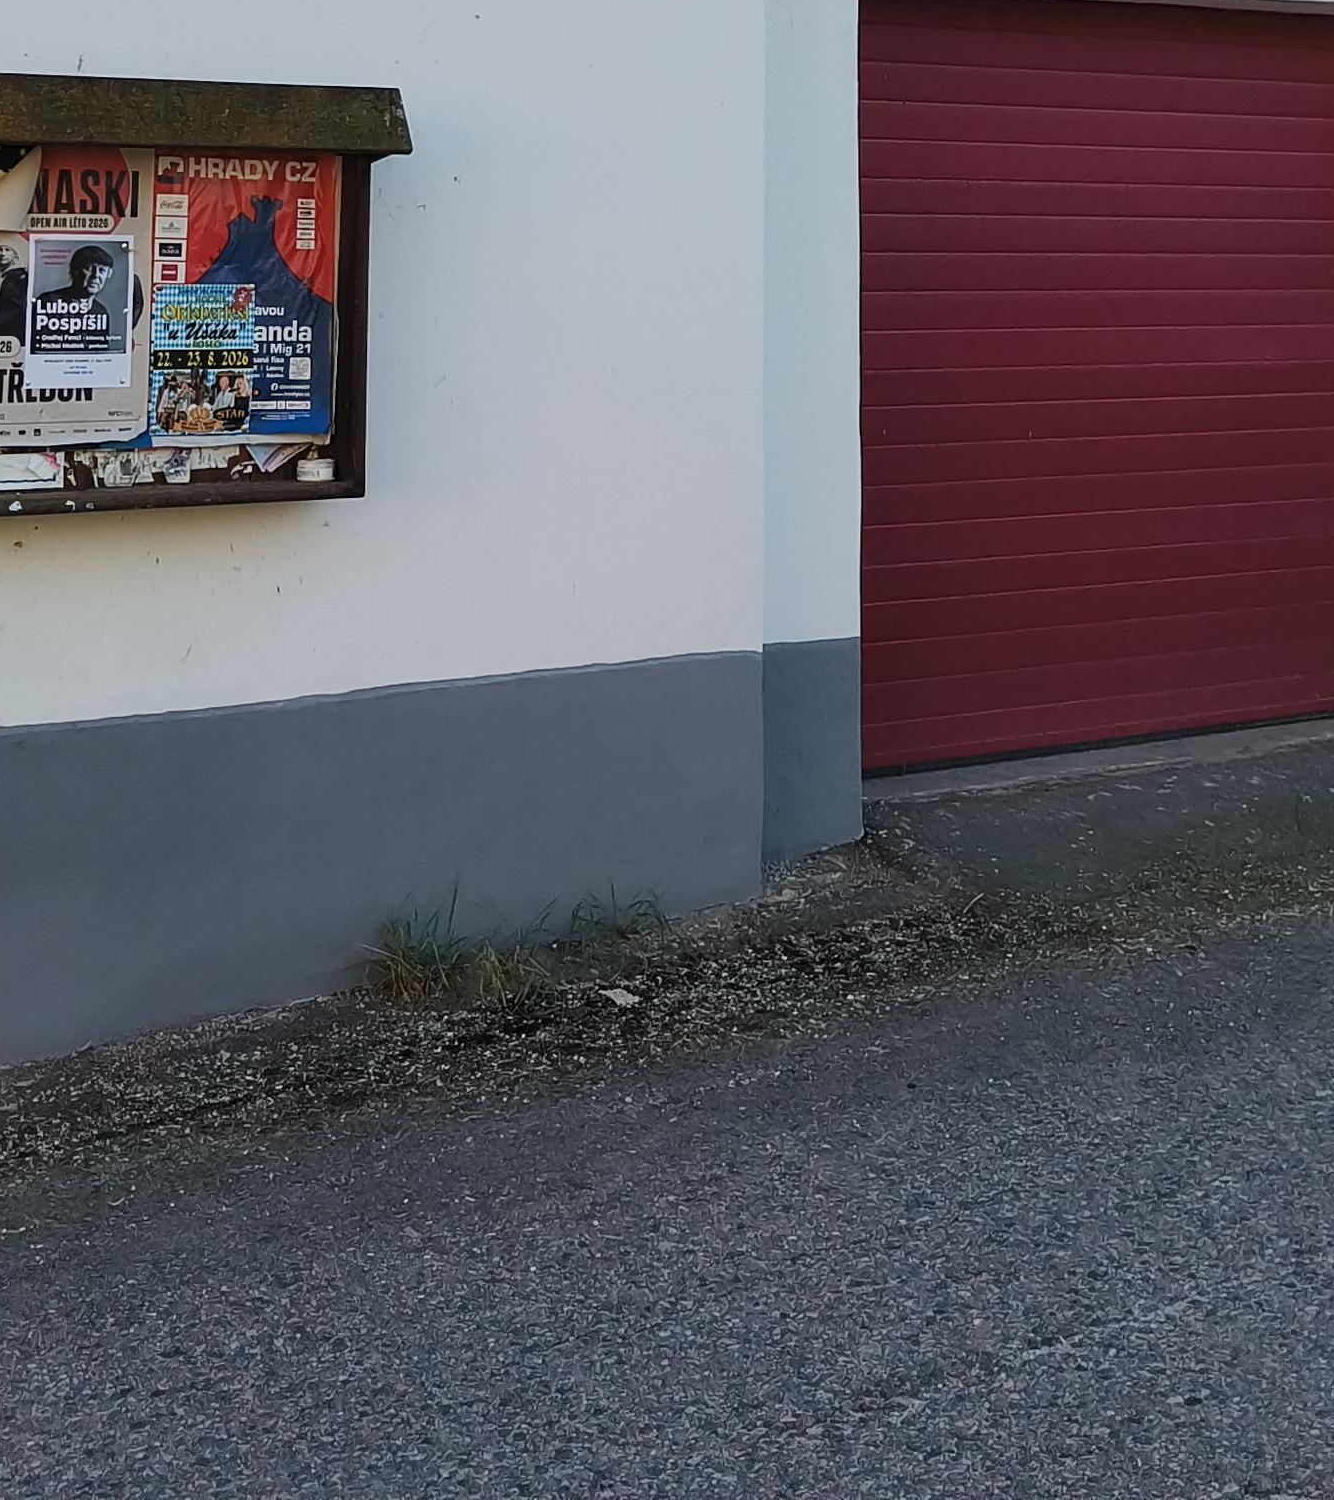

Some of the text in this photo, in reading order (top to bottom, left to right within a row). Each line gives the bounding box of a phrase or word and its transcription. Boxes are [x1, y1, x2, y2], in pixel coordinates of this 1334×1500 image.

[188, 156, 316, 183] HRADY CZ
[30, 217, 51, 228] OPEN
[53, 217, 67, 228] AIR
[69, 215, 87, 228] LÉTO
[36, 299, 89, 314] Luboš
[36, 314, 107, 333] Pospíšil
[270, 343, 292, 356] Mig
[296, 343, 310, 354] 21
[222, 351, 249, 366] 2026
